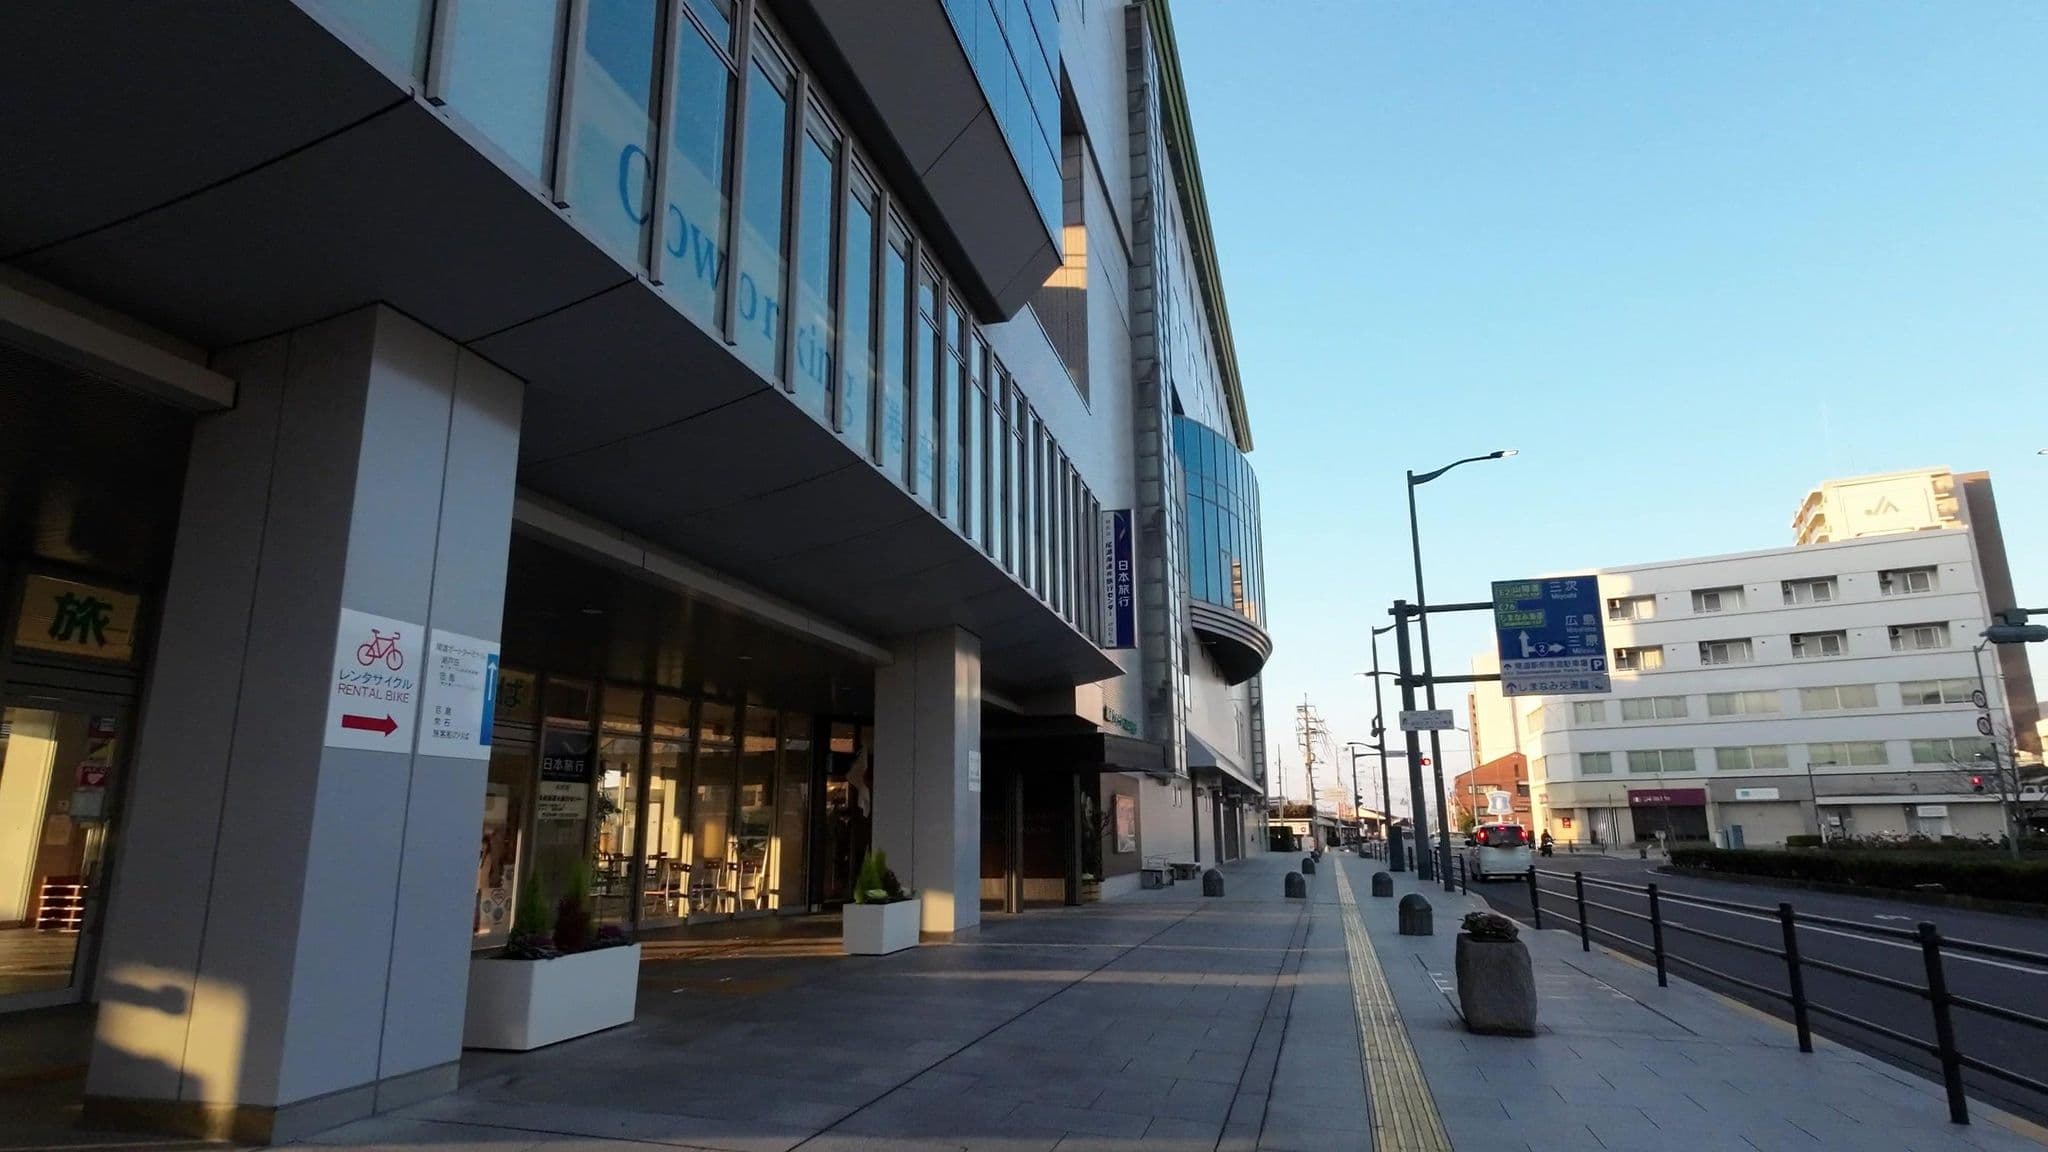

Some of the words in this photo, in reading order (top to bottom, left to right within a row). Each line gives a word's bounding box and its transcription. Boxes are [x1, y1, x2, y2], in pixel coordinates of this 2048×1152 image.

[1118, 560, 1130, 608] 日本旅行
[1549, 580, 1578, 593] 三次
[48, 591, 113, 646] 旅
[1565, 614, 1596, 626] 広島
[1568, 634, 1599, 647] 三原
[1539, 644, 1546, 653] 2
[1592, 660, 1603, 670] P
[339, 668, 413, 690] レンタサイクル
[337, 683, 383, 700] RENTAL
[385, 690, 410, 704] BIKE
[543, 757, 584, 772] 日本旅行
